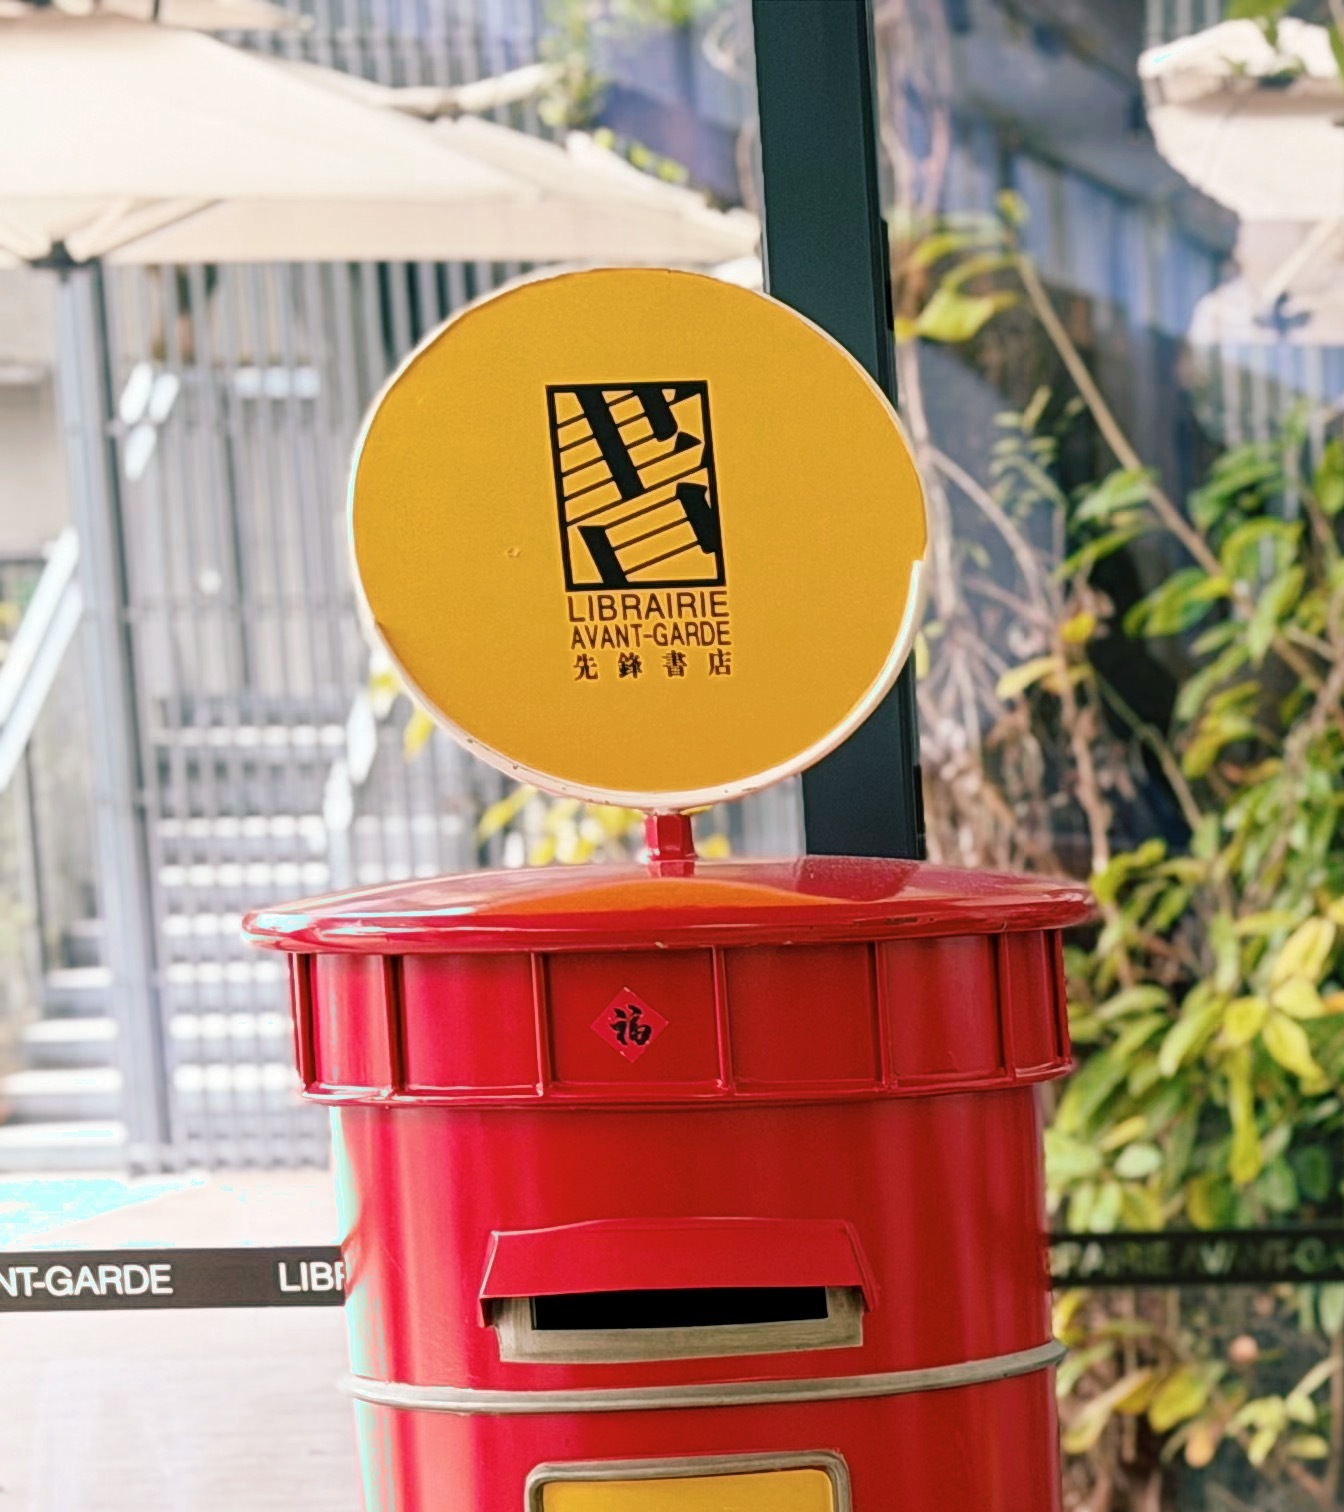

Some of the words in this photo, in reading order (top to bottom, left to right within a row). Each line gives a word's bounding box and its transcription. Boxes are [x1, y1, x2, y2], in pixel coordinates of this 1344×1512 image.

[568, 591, 730, 622] LIBRAIRIE
[571, 621, 732, 650] AVANT-GARDE
[574, 649, 732, 680] 先鋒書店
[610, 1004, 652, 1046] 福
